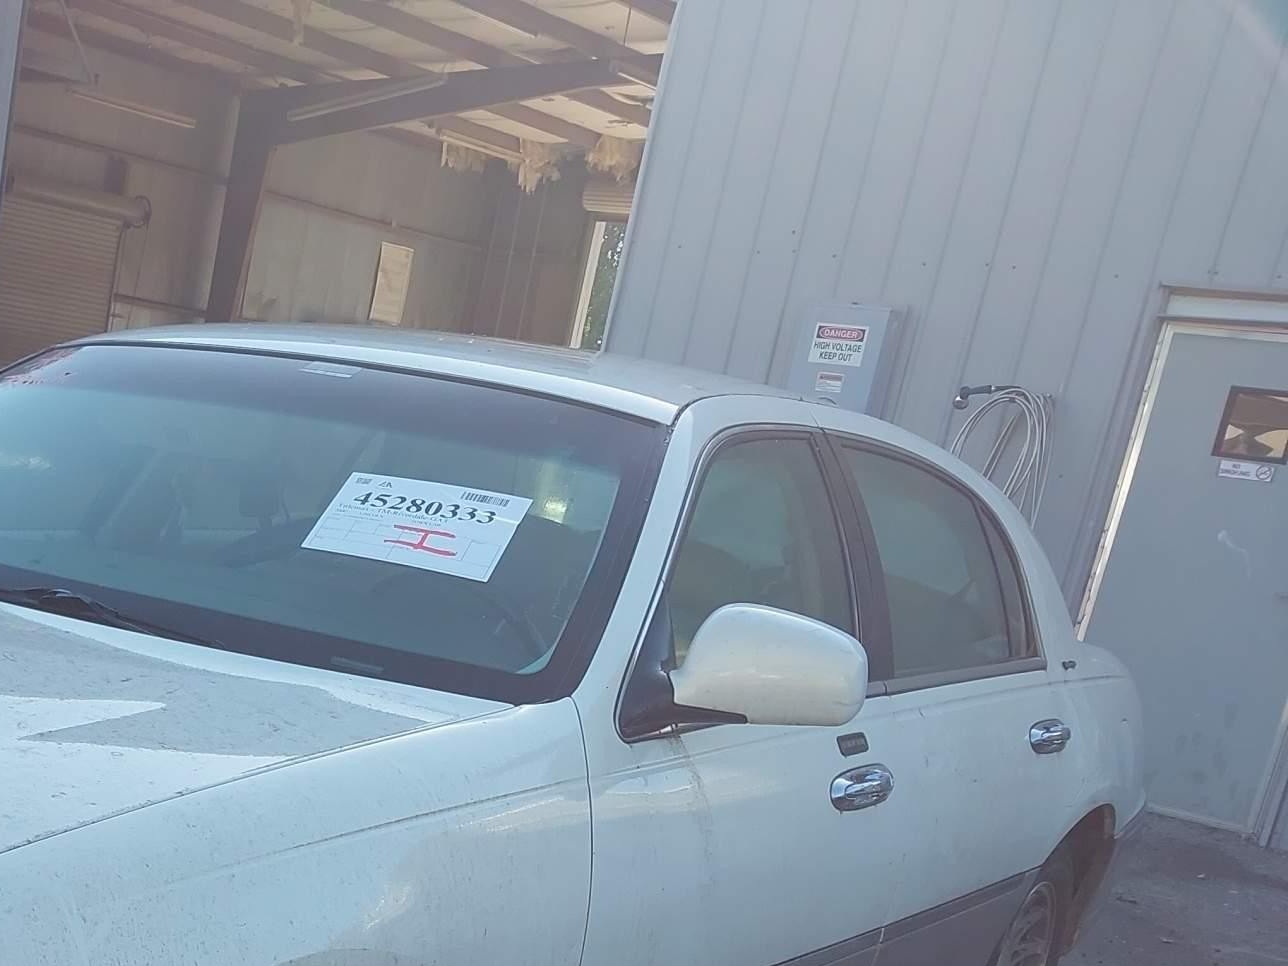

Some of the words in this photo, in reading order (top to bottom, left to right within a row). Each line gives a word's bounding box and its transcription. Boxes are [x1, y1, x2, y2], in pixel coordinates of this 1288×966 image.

[824, 329, 858, 339] DANGER
[814, 341, 830, 350] HIGH
[832, 343, 862, 353] VOLTAGE
[819, 351, 837, 360] KEEP
[838, 353, 853, 361] OUT
[353, 491, 496, 524] 45280333
